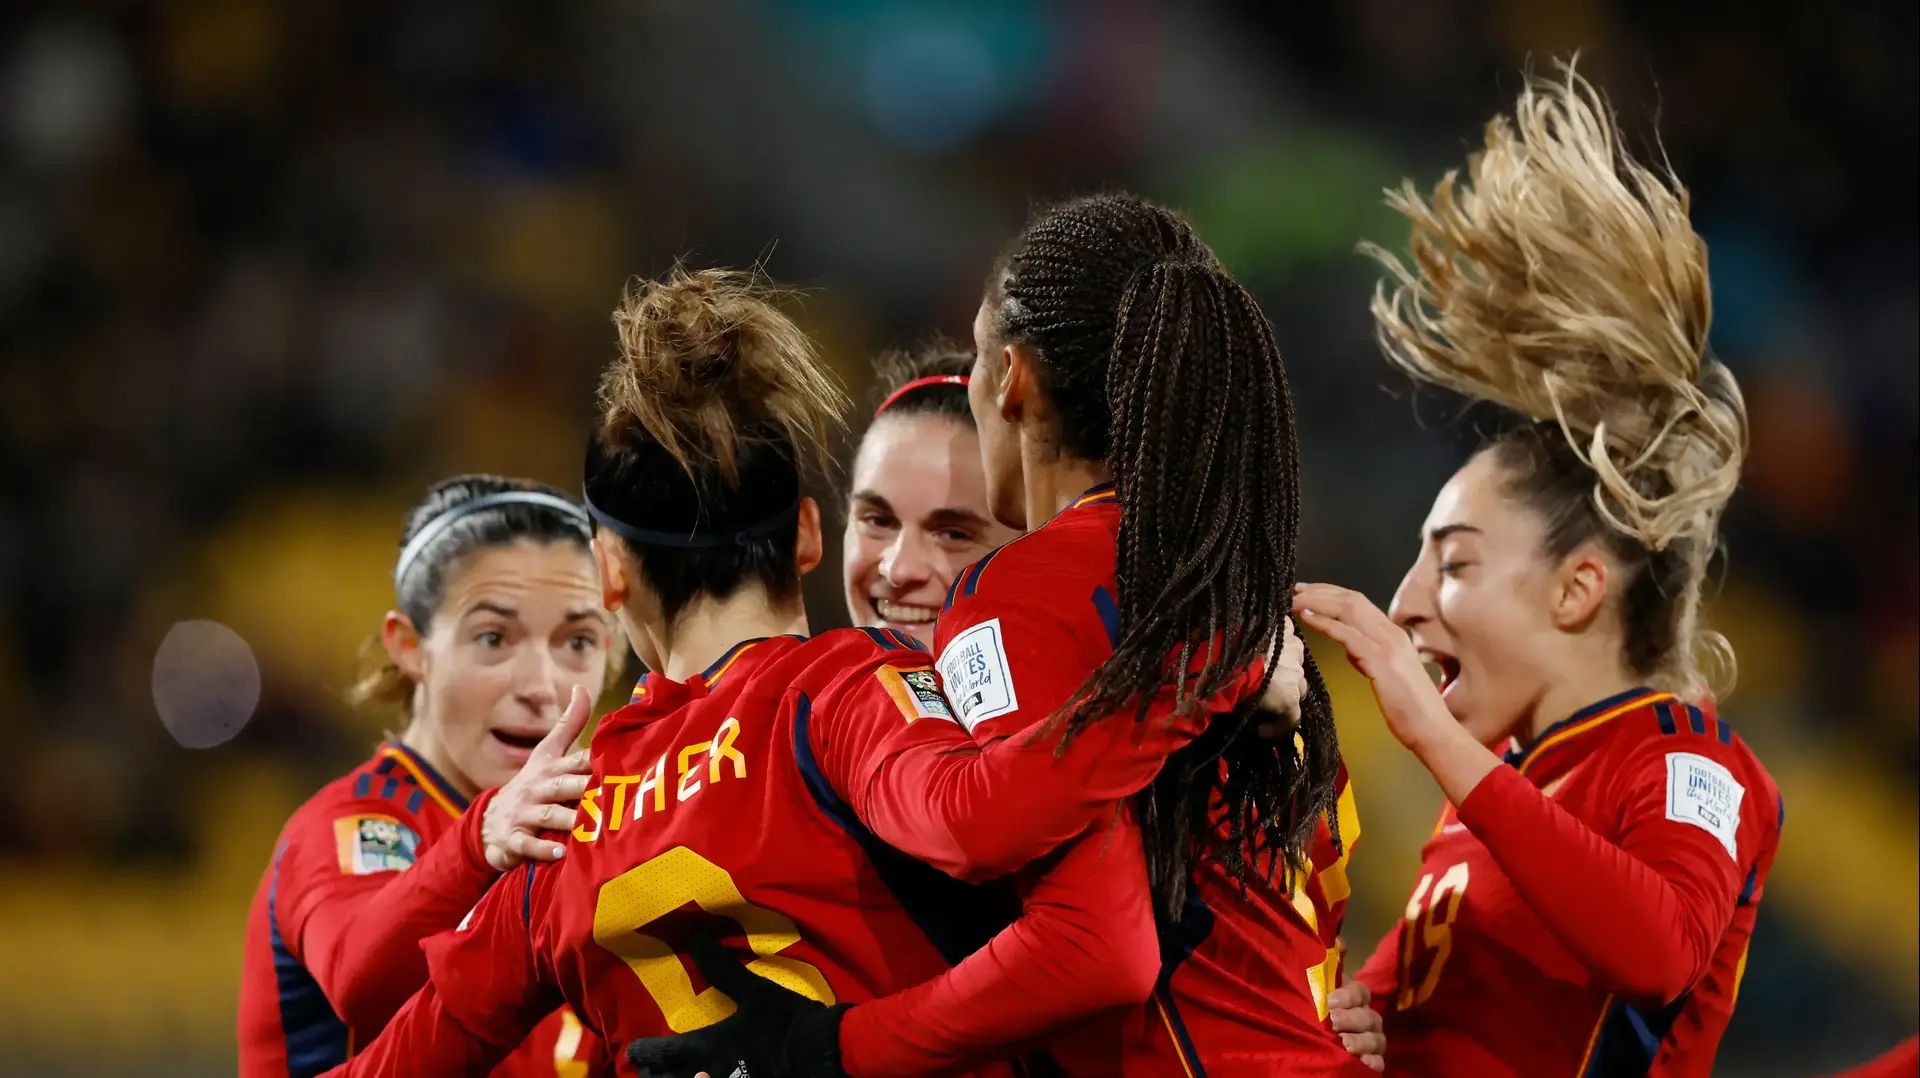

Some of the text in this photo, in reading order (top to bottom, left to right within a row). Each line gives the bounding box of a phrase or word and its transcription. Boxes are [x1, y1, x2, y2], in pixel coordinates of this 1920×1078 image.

[947, 642, 982, 678] FOOTBALL
[950, 654, 986, 694] UNITES
[572, 716, 746, 842] STHER
[1689, 775, 1732, 808] UNITES
[1397, 862, 1470, 1012] 19
